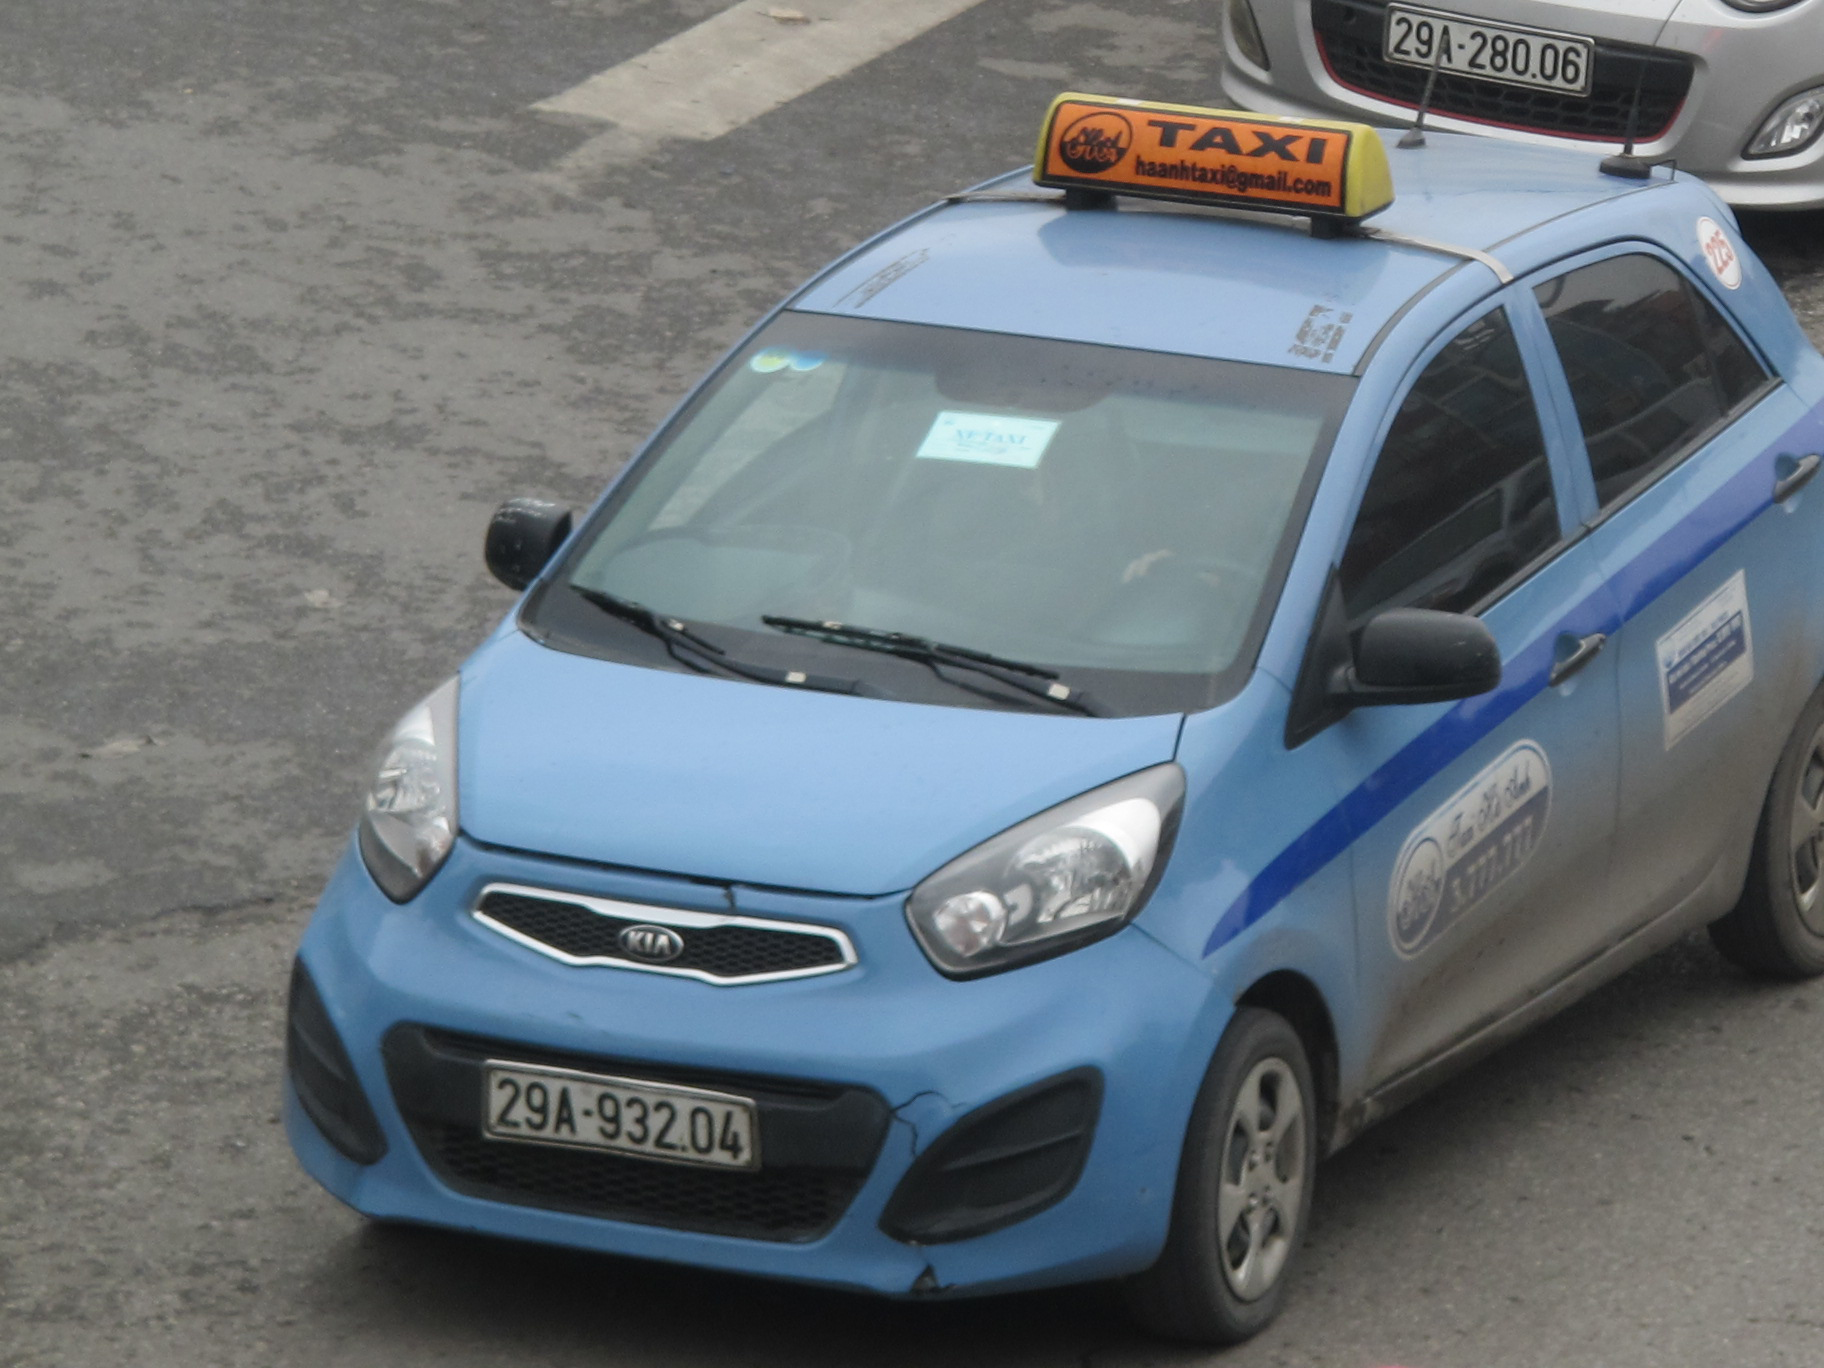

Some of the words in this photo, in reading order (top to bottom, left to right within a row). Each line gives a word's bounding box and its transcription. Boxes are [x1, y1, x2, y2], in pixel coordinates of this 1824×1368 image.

[1393, 16, 1581, 85] 29A-280.06
[1148, 119, 1329, 165] TAXI
[1135, 154, 1332, 198] haanhtaxi@gmail.com
[629, 931, 671, 954] KIA
[497, 1076, 743, 1161] 29A-932.04
